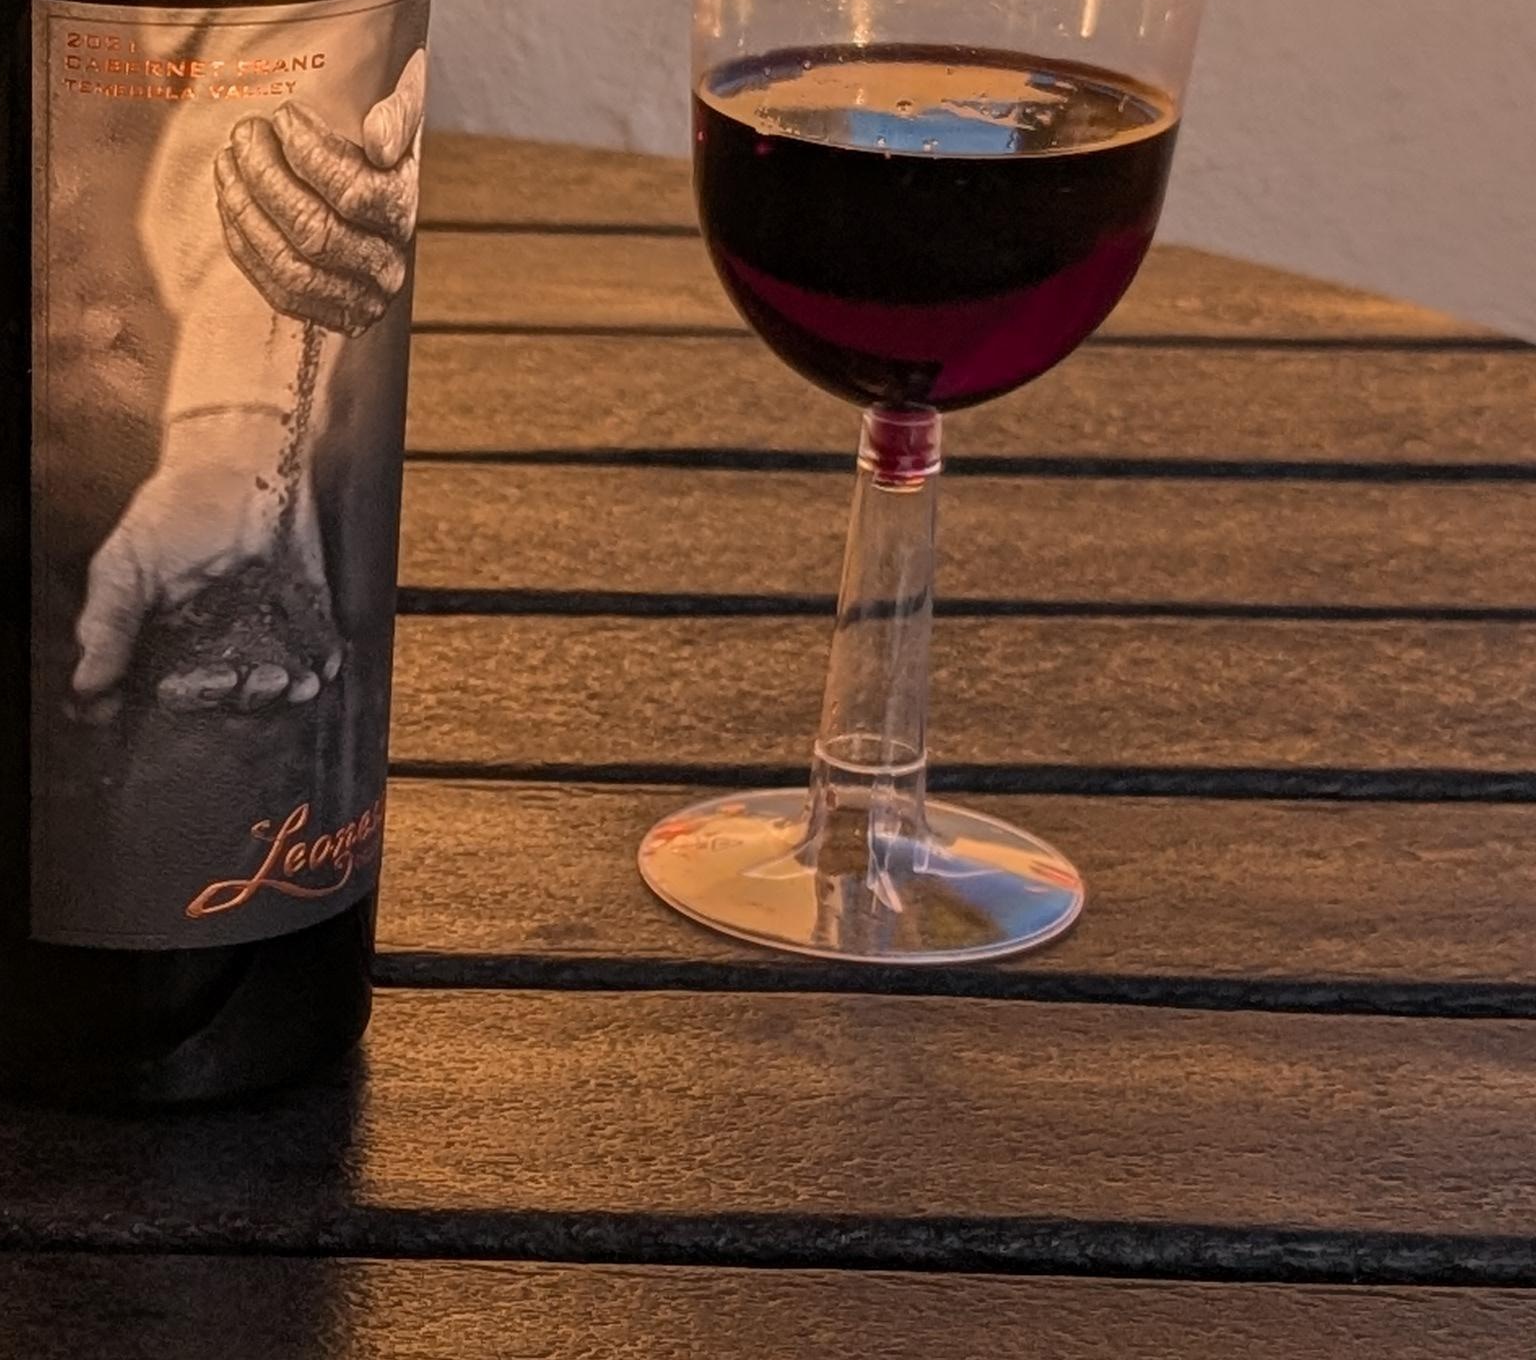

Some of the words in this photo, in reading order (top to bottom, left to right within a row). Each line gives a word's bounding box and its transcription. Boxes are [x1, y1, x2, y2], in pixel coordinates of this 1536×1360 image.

[62, 54, 225, 78] CABERNET
[238, 53, 326, 77] FRANC
[208, 81, 297, 99] VALLEY
